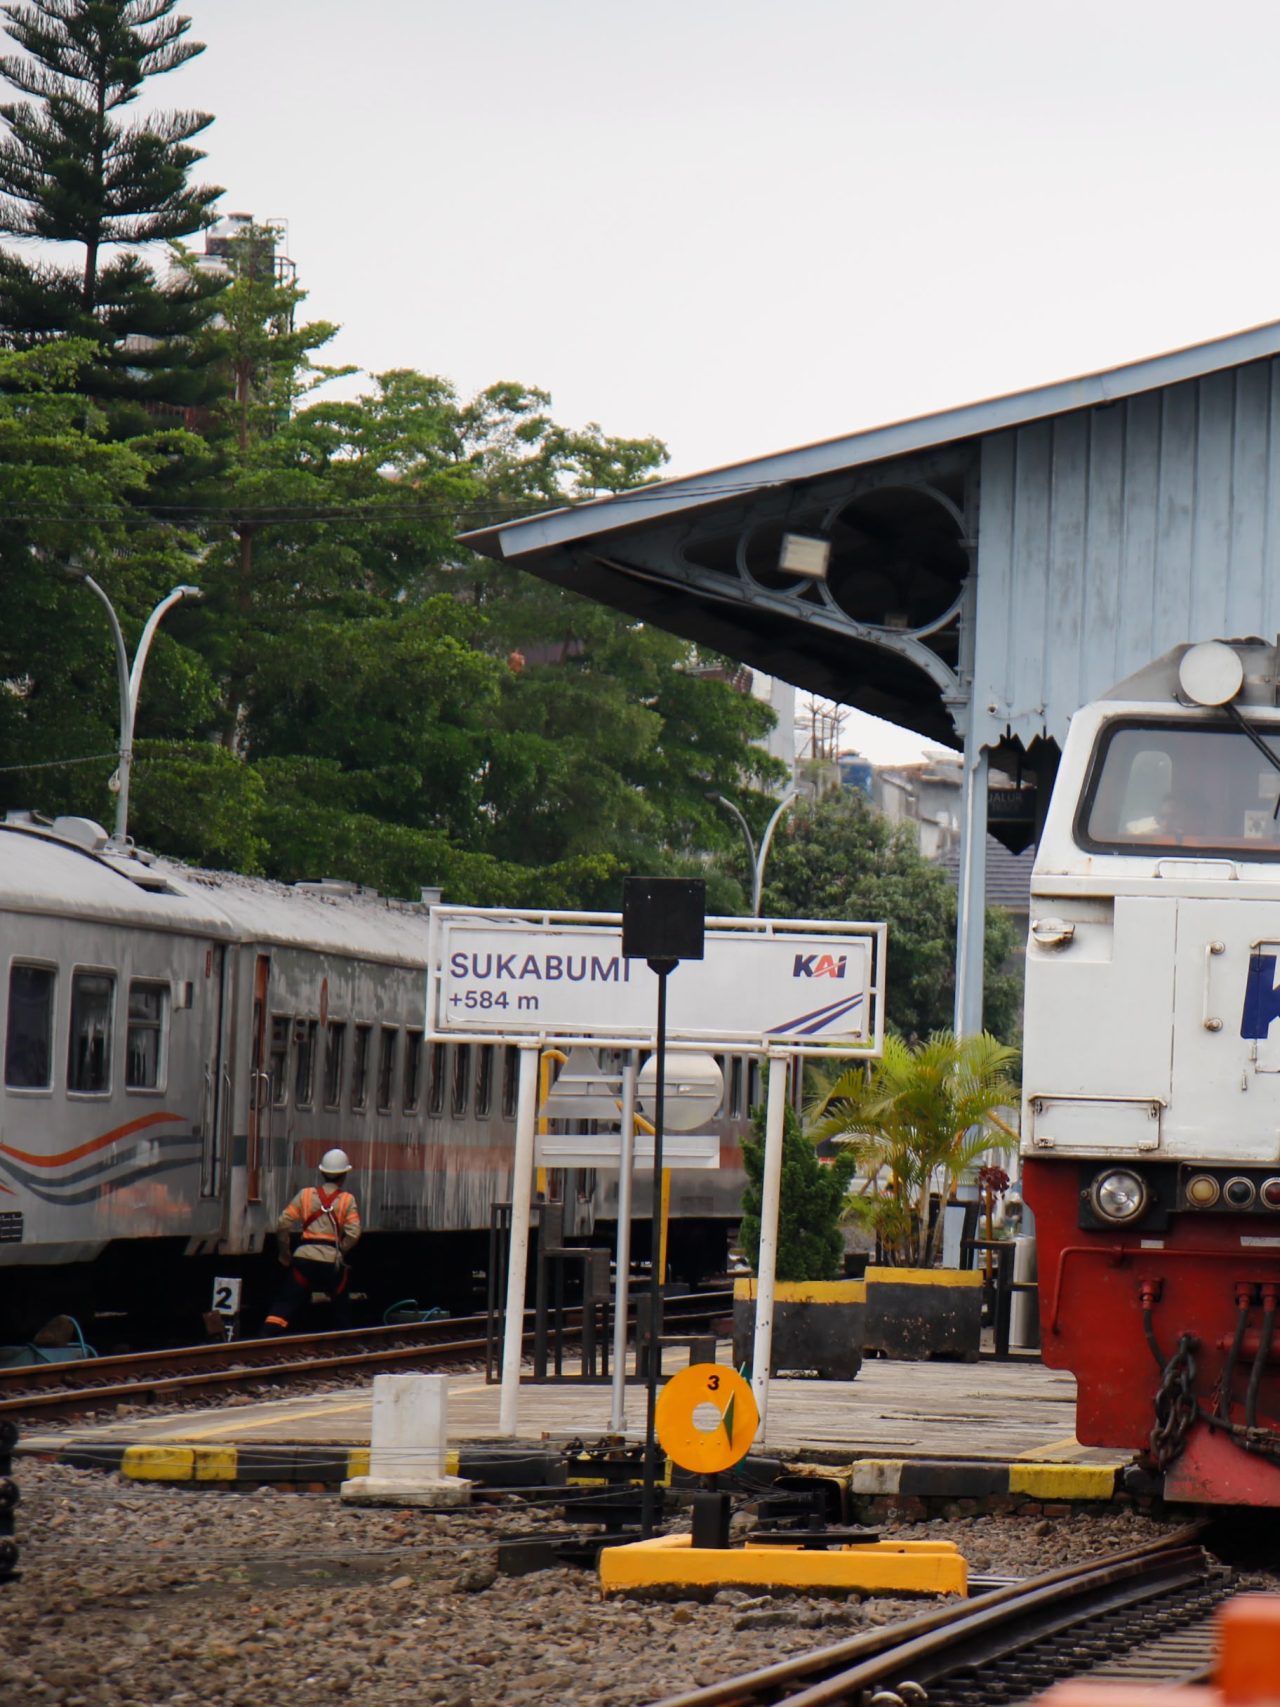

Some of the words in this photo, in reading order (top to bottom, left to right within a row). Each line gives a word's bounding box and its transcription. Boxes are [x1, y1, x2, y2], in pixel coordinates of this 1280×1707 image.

[450, 952, 630, 982] SUKABUMI
[793, 954, 847, 978] KAI
[449, 990, 510, 1010] +584
[517, 995, 540, 1010] m
[215, 1286, 232, 1310] 2
[707, 1374, 720, 1391] 3
